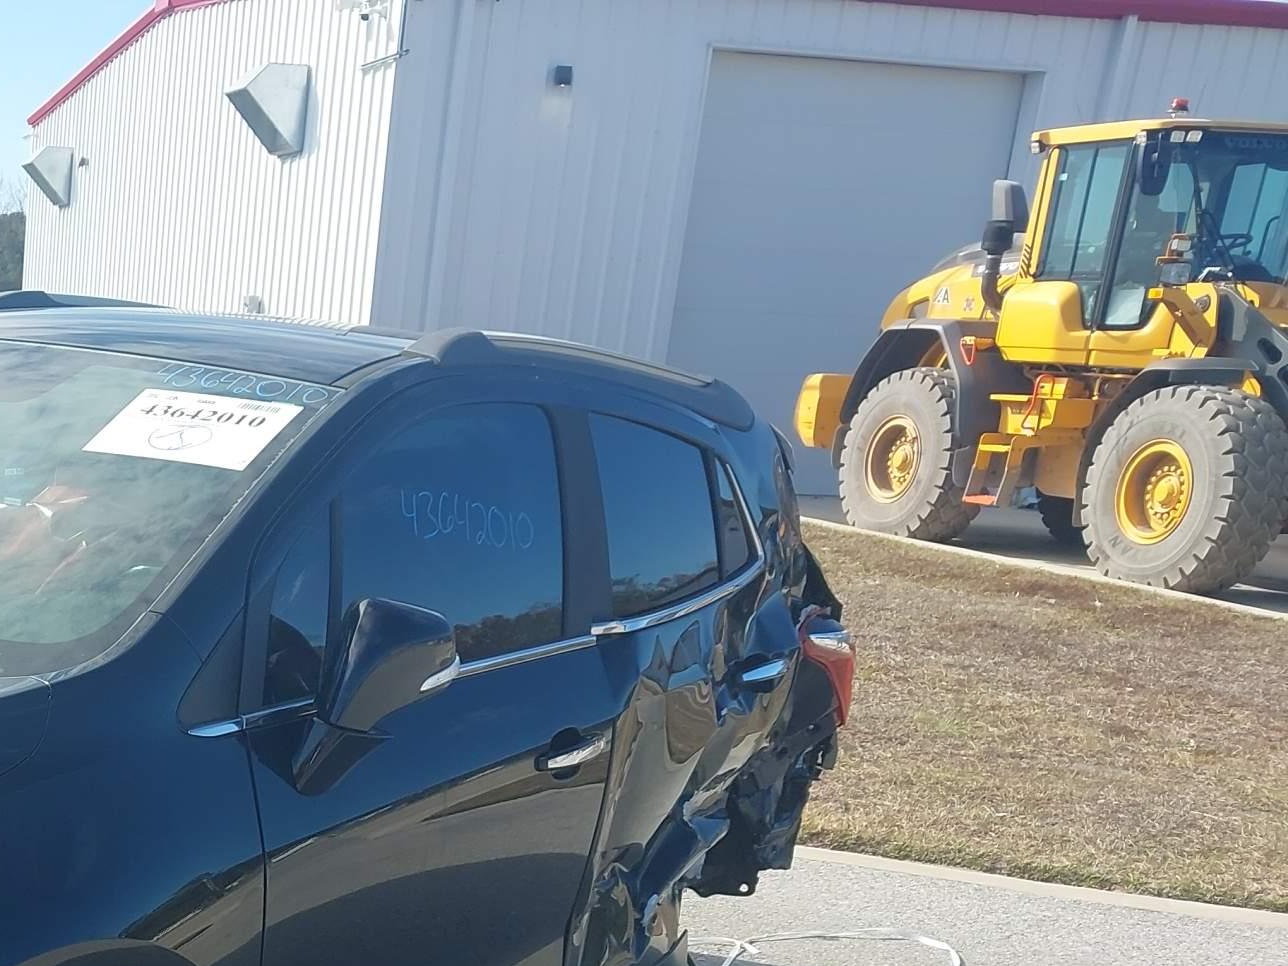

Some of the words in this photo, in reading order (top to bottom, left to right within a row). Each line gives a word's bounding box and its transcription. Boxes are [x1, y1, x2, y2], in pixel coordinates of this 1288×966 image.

[156, 363, 328, 403] 43642010
[140, 404, 266, 428] 43642010
[401, 488, 534, 549] 43642010
